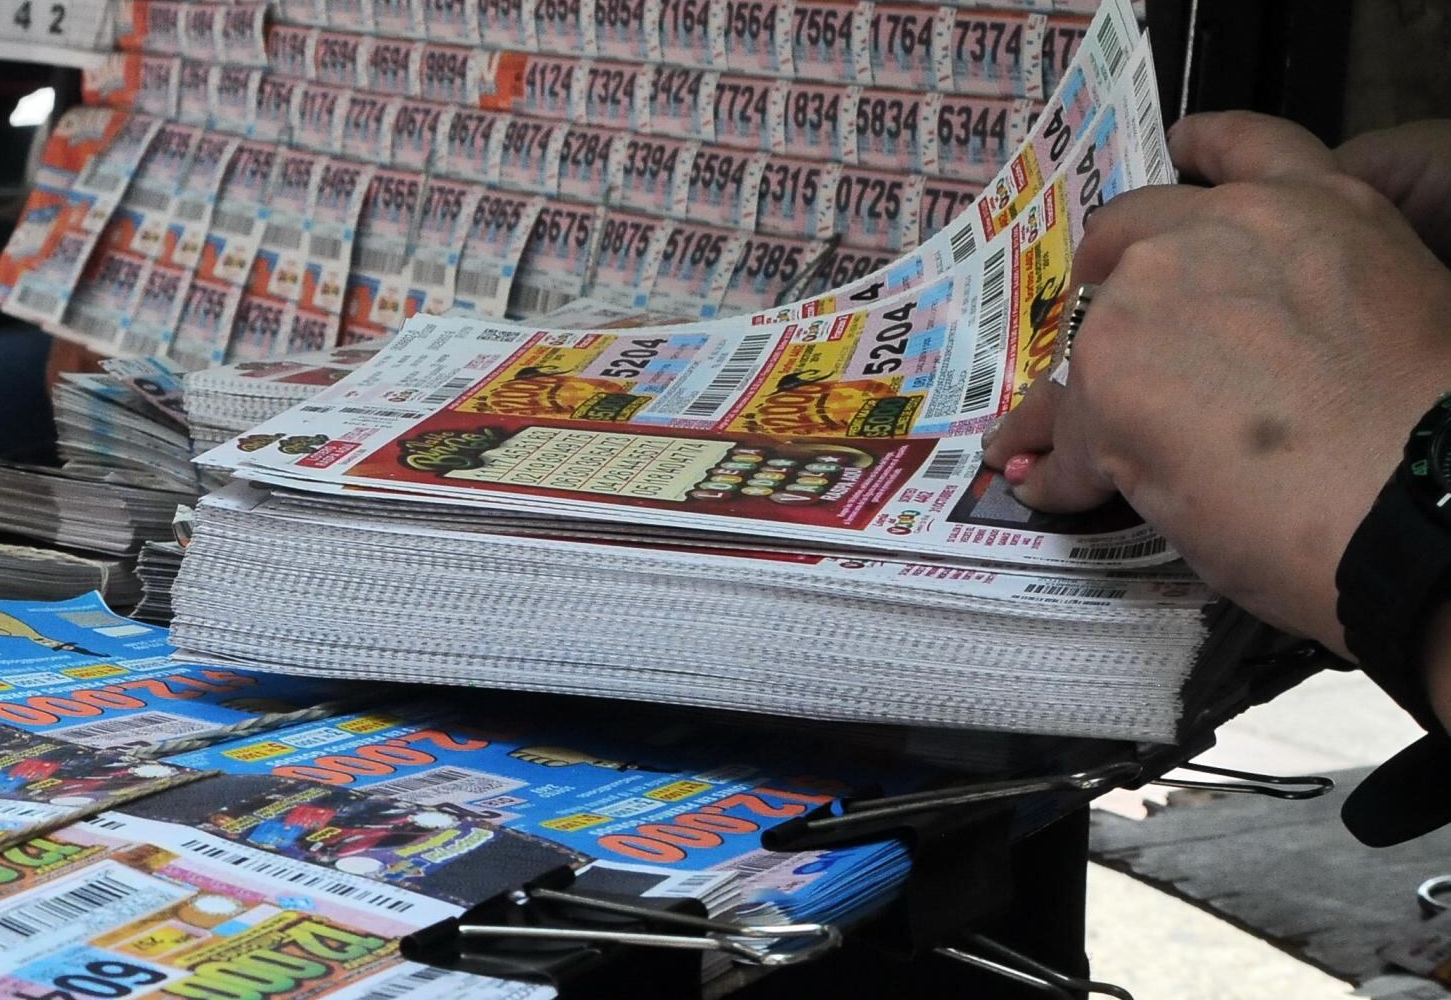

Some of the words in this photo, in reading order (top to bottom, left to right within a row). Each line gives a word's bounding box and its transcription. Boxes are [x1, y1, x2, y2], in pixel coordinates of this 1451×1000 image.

[794, 6, 852, 47] 7564
[870, 13, 934, 57] 1764
[955, 19, 1022, 66] 7374
[856, 96, 918, 139] 5834
[938, 104, 1007, 150] 6344
[759, 163, 821, 207] 6315
[836, 174, 903, 222] 0725
[601, 337, 669, 379] 5204
[862, 301, 917, 376] 5204
[819, 481, 851, 502] RASPA
